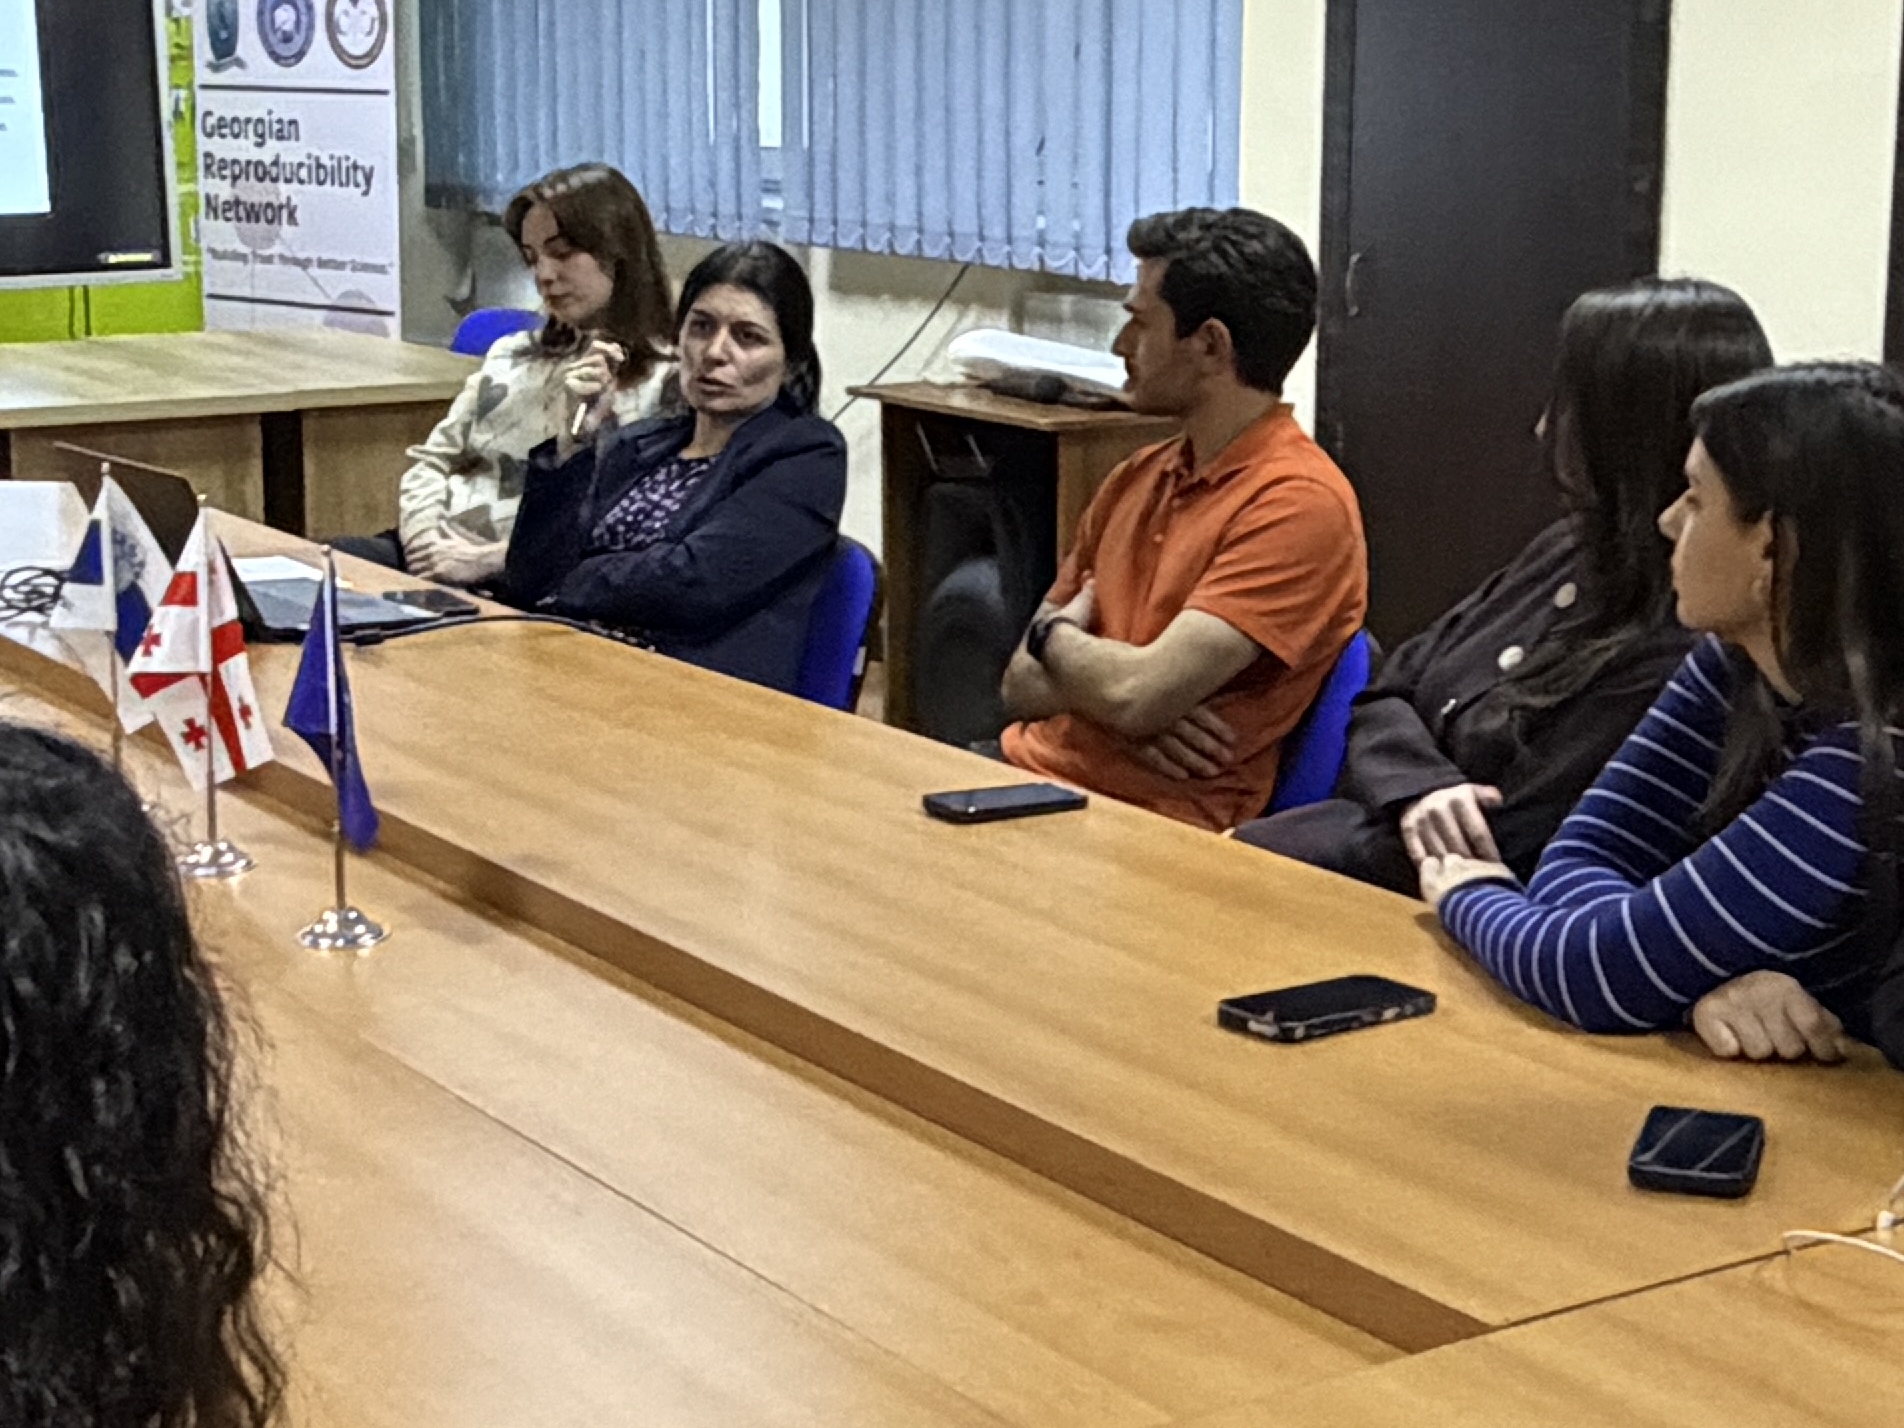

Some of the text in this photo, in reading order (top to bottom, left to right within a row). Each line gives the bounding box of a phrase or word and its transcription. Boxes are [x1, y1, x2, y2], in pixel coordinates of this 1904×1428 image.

[201, 109, 300, 148] Georgian
[202, 151, 375, 197] Reproducibility
[204, 192, 299, 227] Network
